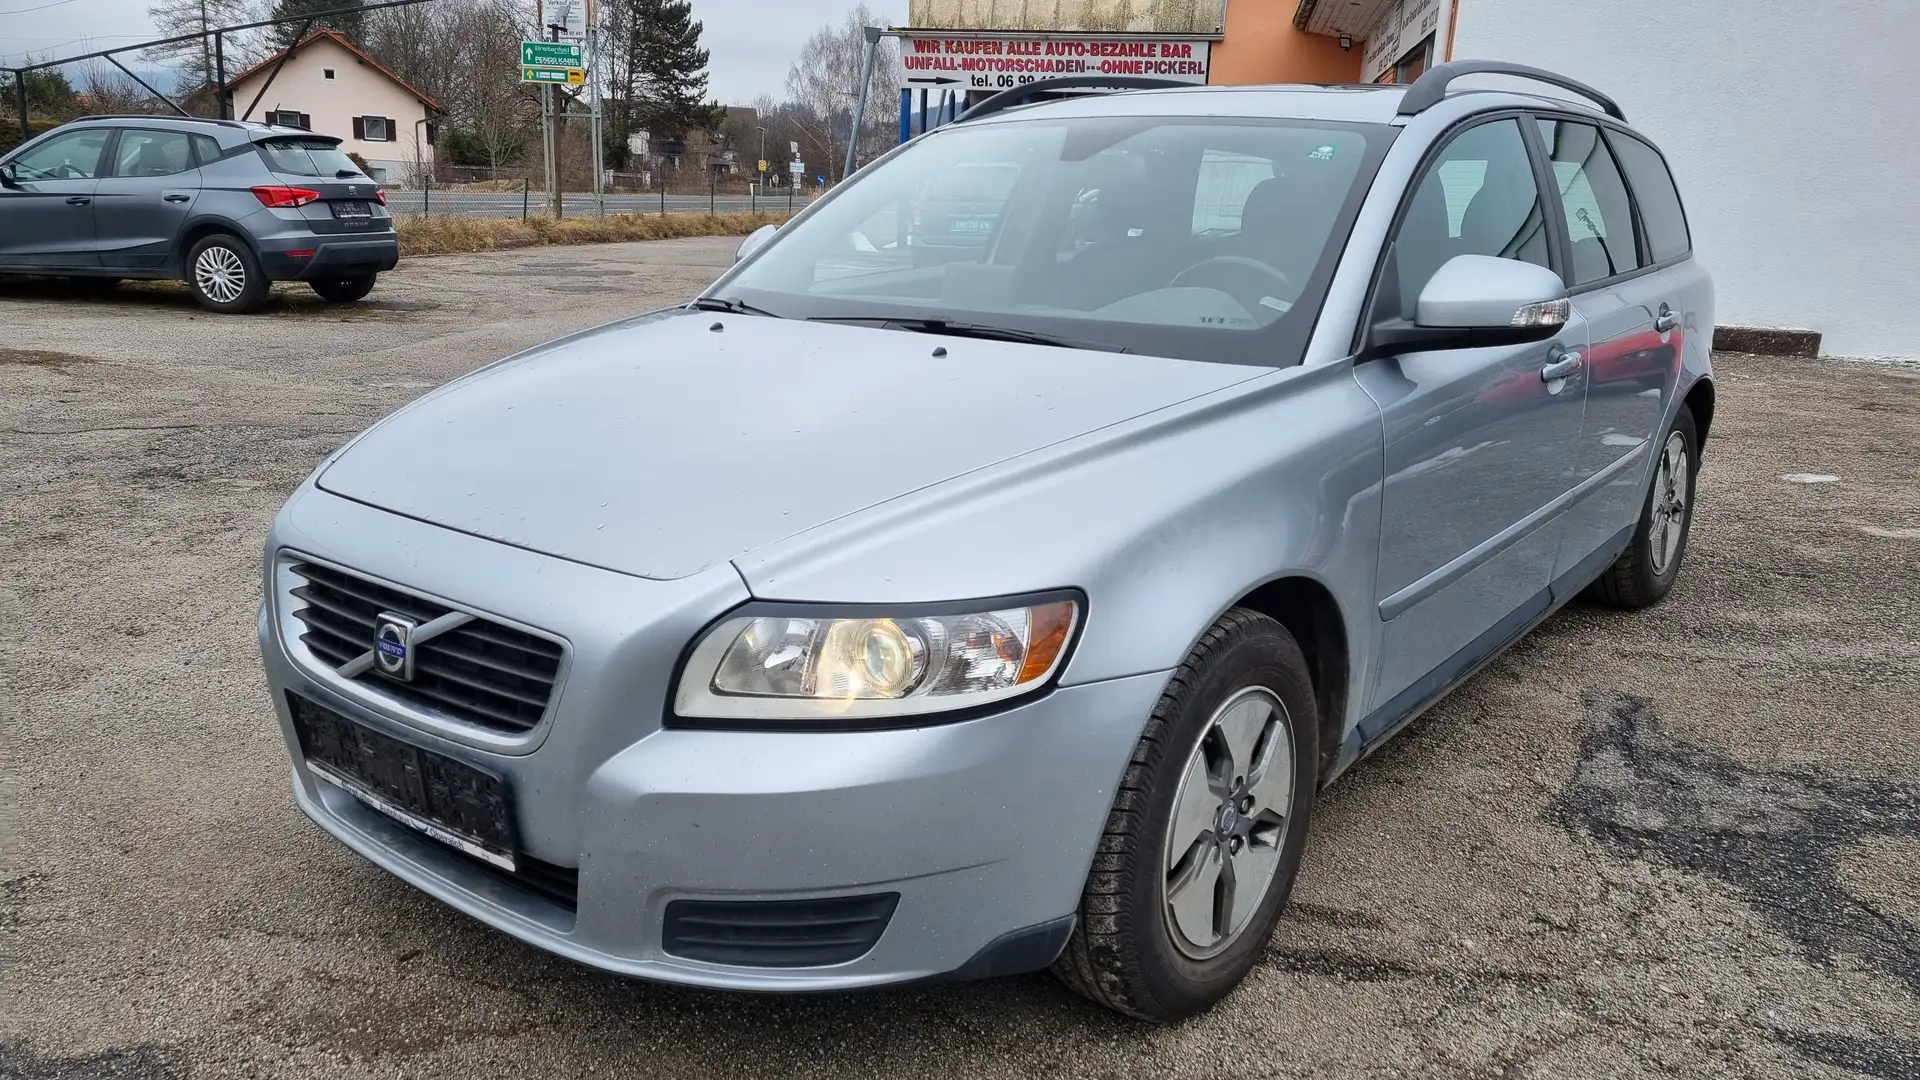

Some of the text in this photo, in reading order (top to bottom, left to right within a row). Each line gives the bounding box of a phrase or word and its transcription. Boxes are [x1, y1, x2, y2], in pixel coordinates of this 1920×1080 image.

[913, 40, 941, 54] WIR
[945, 40, 1003, 55] KAUFEN
[1007, 41, 1042, 56] ALLE
[1160, 43, 1192, 58] BAR
[971, 74, 993, 87] tel.
[997, 75, 1014, 88] 06
[379, 641, 403, 655] VOLVO
